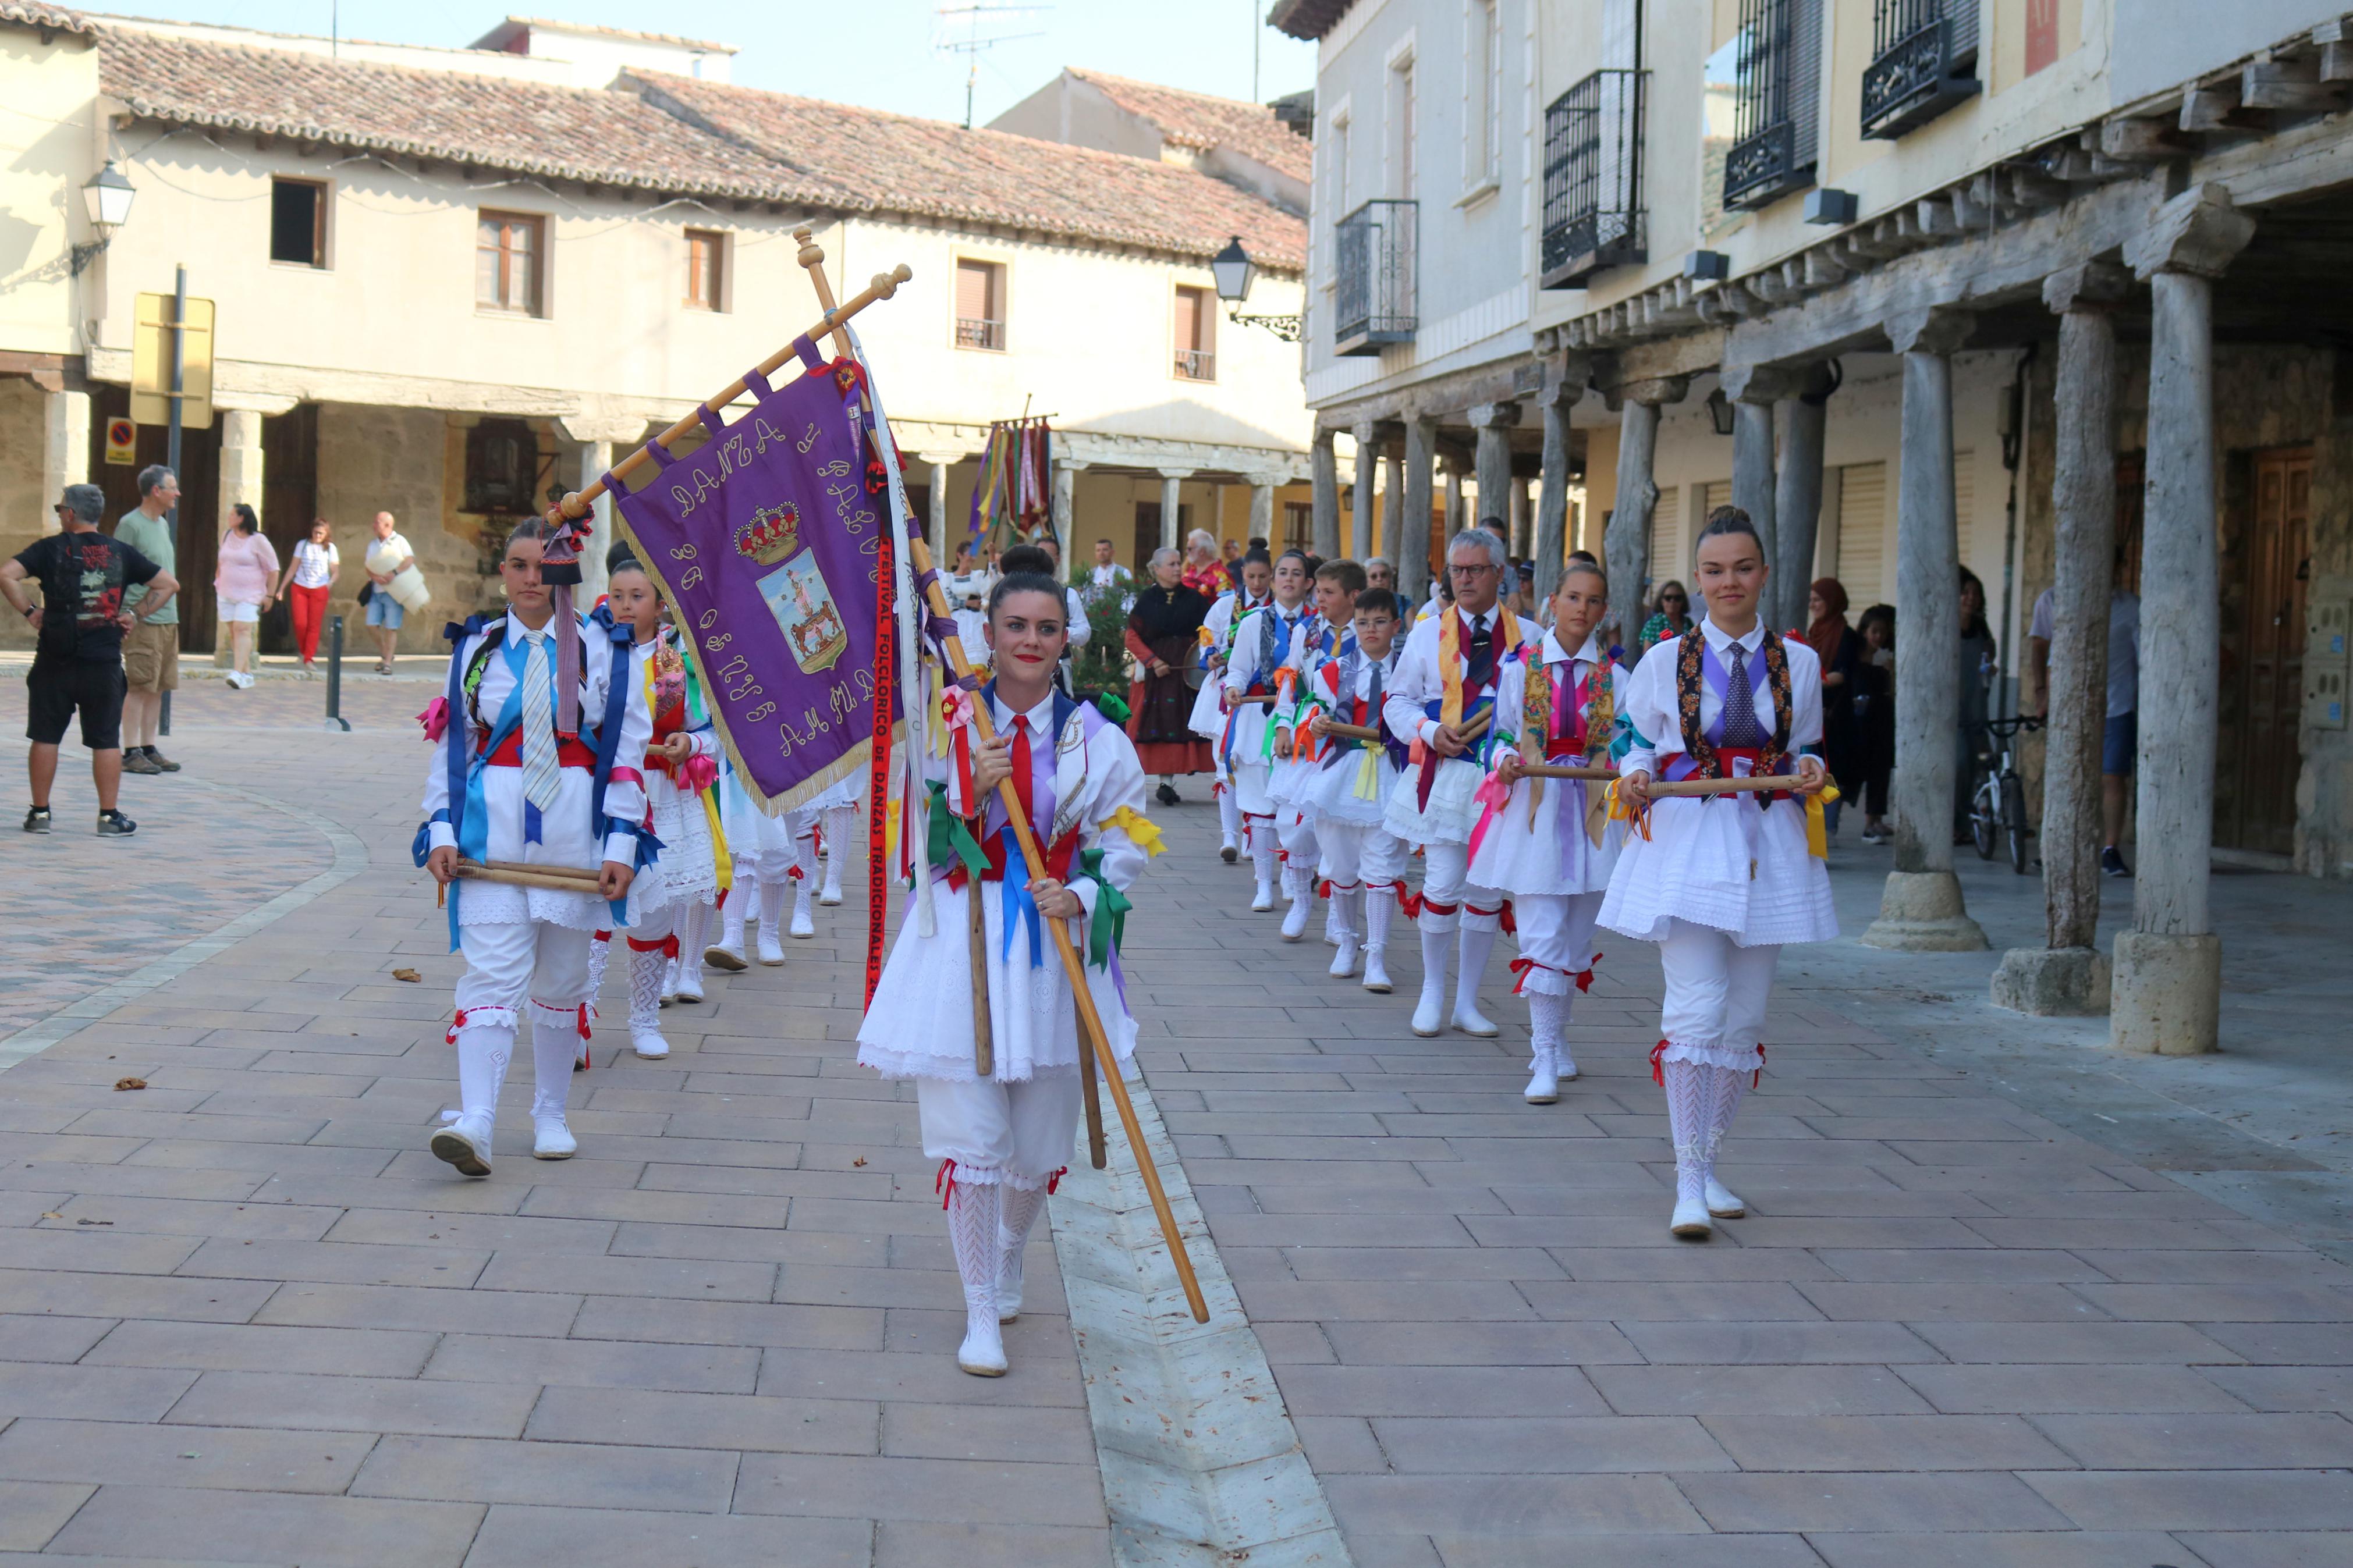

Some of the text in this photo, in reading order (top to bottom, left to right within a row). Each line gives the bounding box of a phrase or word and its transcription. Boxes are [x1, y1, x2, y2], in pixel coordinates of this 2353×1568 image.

[671, 418, 786, 517] DANZA
[797, 422, 822, 453] Y
[670, 543, 703, 591] DE
[881, 552, 889, 623] FESTIVAL
[876, 635, 889, 735] FOLCLORICO
[875, 746, 884, 762] DE
[873, 772, 885, 835] DANZAS
[871, 847, 882, 971] TRADICIONALES
